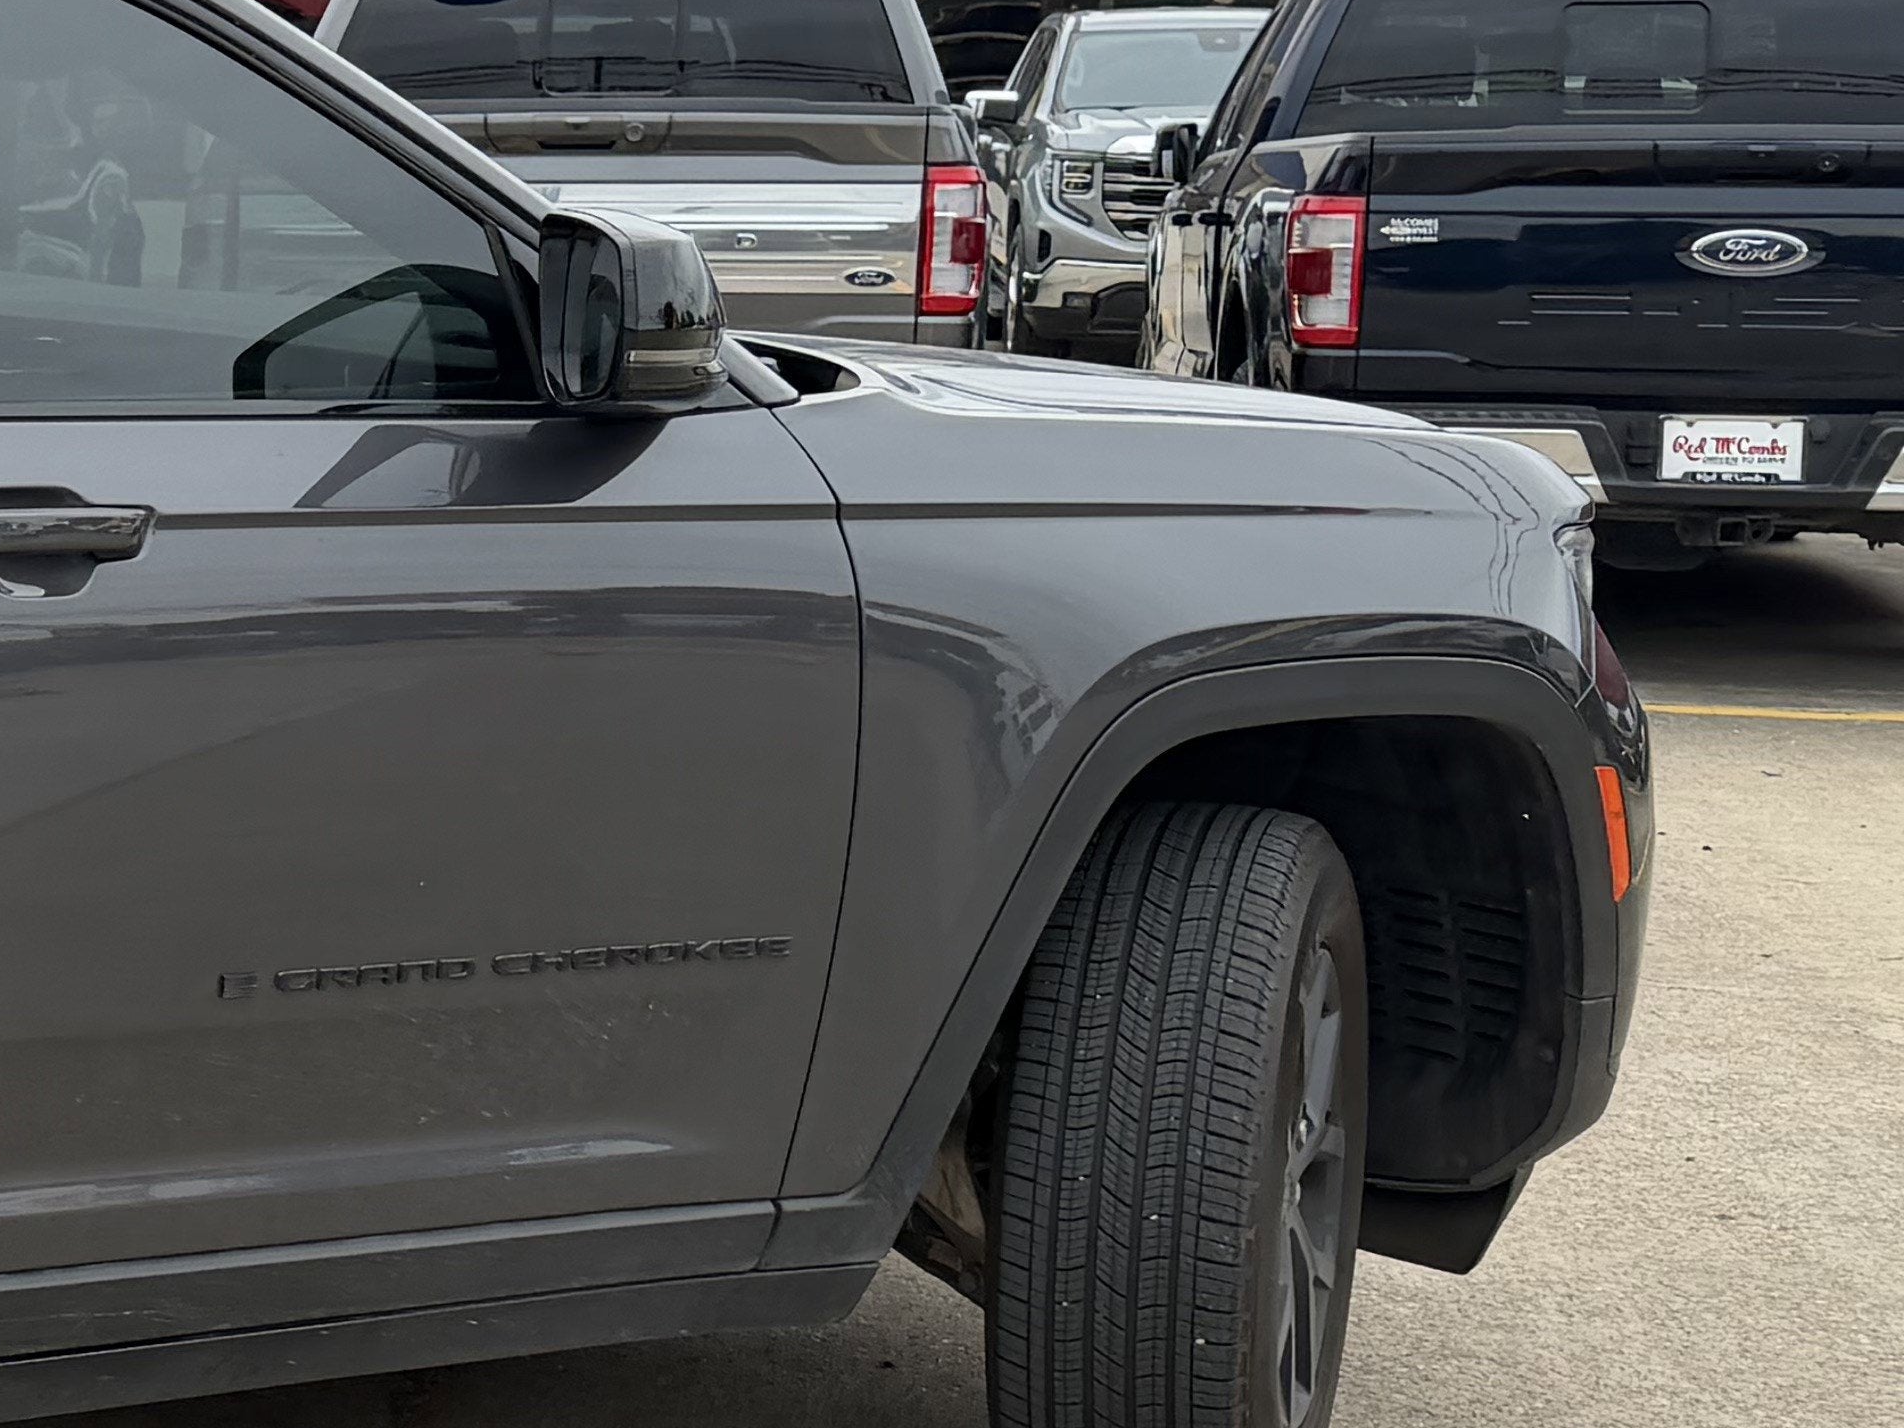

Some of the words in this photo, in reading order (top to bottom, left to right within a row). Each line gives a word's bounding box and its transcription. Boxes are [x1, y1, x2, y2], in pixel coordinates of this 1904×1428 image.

[1718, 238, 1782, 262] Ford
[1672, 435, 1708, 462] Red
[274, 957, 477, 991] GRAND
[492, 937, 793, 975] CHEROKEE
